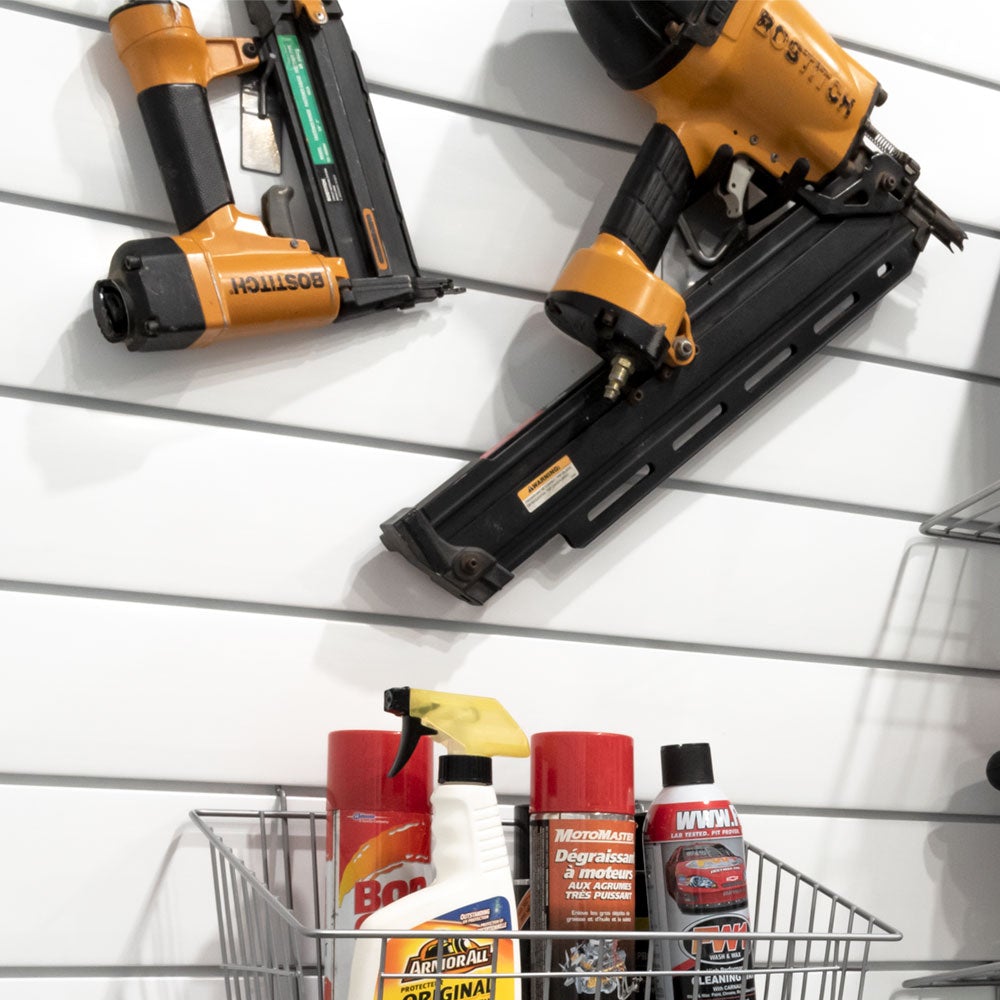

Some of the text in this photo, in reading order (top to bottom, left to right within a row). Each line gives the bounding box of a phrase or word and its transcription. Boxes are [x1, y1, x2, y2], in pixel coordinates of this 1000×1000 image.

[231, 272, 325, 295] BOSTITCH
[563, 866, 633, 880] à moteurs
[568, 882, 632, 890] AUX AGRUMES
[565, 890, 591, 900] TRÈS
